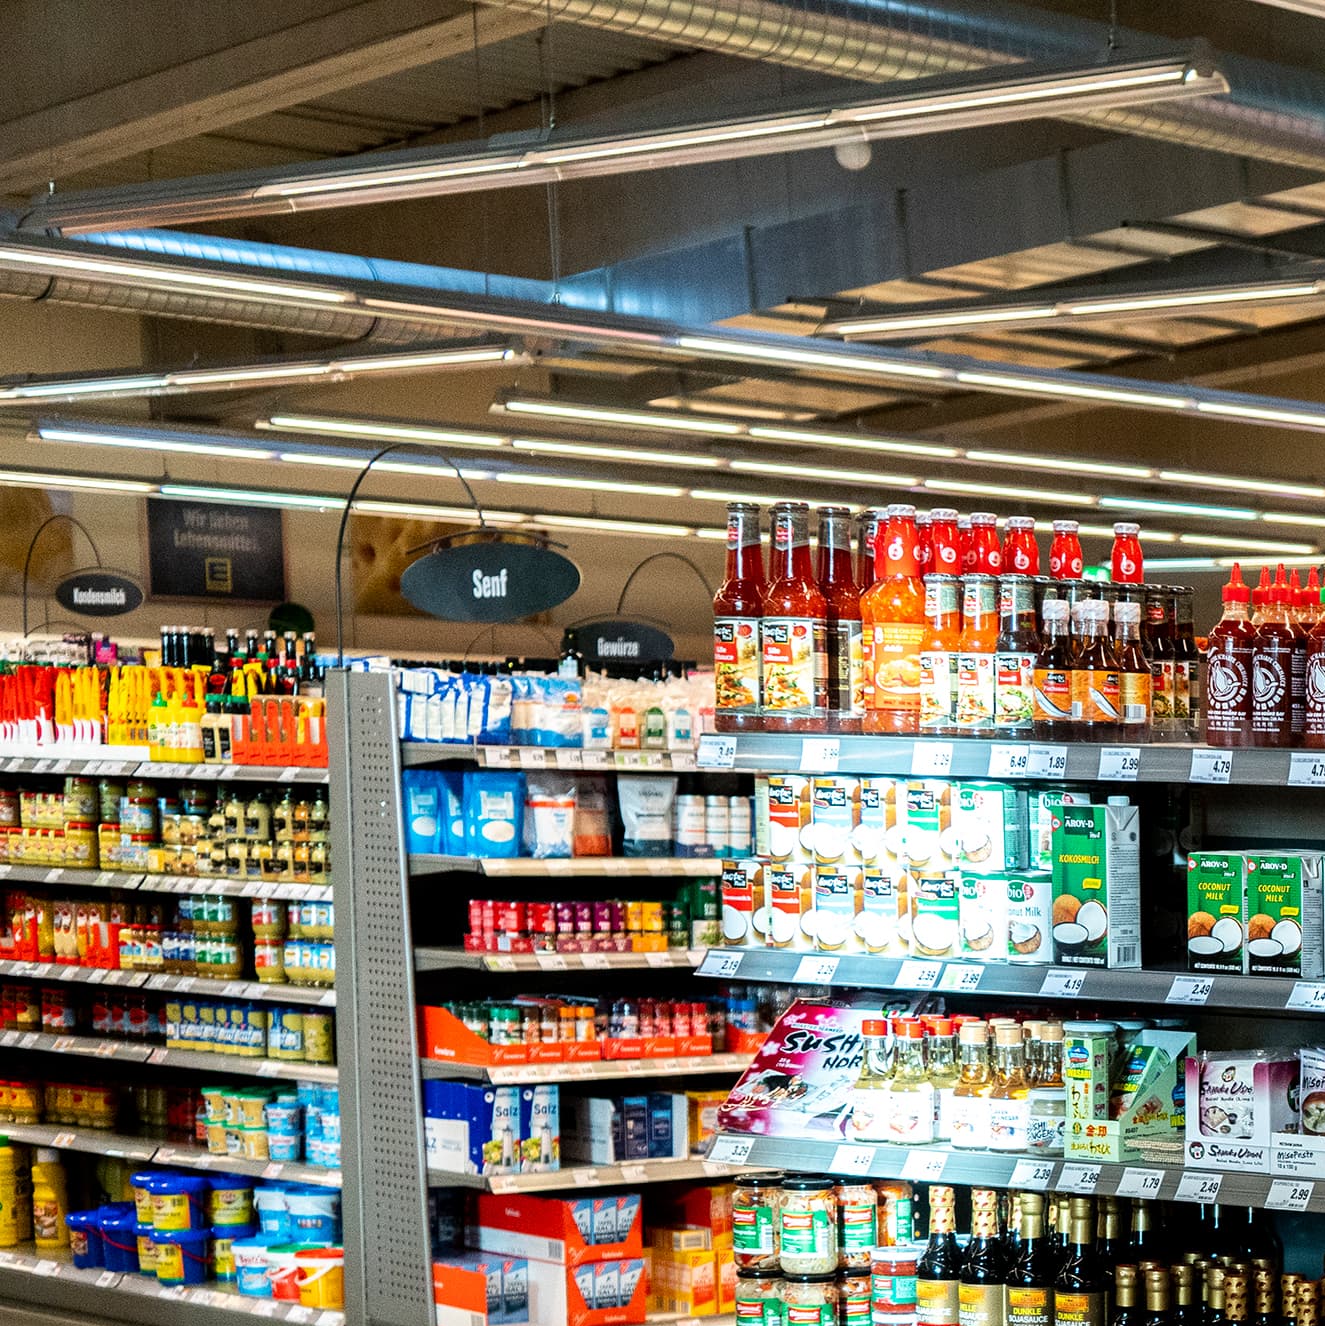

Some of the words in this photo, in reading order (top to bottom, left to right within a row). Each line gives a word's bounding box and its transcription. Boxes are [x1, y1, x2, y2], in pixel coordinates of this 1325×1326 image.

[472, 569, 508, 599] Senf
[597, 636, 639, 659] Gewürze
[1010, 756, 1027, 767] 6.49
[1050, 757, 1065, 768] 1.89
[1122, 758, 1138, 770] 2.99
[1213, 762, 1230, 773] 4.79
[1059, 855, 1100, 864] KOKOSMILCH
[1198, 882, 1231, 892] COCONUT
[1258, 884, 1290, 894] COCONUT
[1205, 892, 1224, 901] MILK
[1265, 894, 1283, 903] MILK
[1064, 980, 1082, 990] 4.19
[1192, 985, 1210, 996] 2.49
[495, 1105, 518, 1118] Salz
[534, 1104, 557, 1115] Salz
[1033, 1169, 1051, 1179] 2.39
[1081, 1172, 1099, 1183] 2.99
[1142, 1177, 1160, 1189] 1.79
[1200, 1182, 1218, 1193] 2.49
[1291, 1189, 1309, 1200] 2.99
[1013, 1307, 1041, 1315] DUNKLE
[1058, 1313, 1084, 1321] DUNKLE
